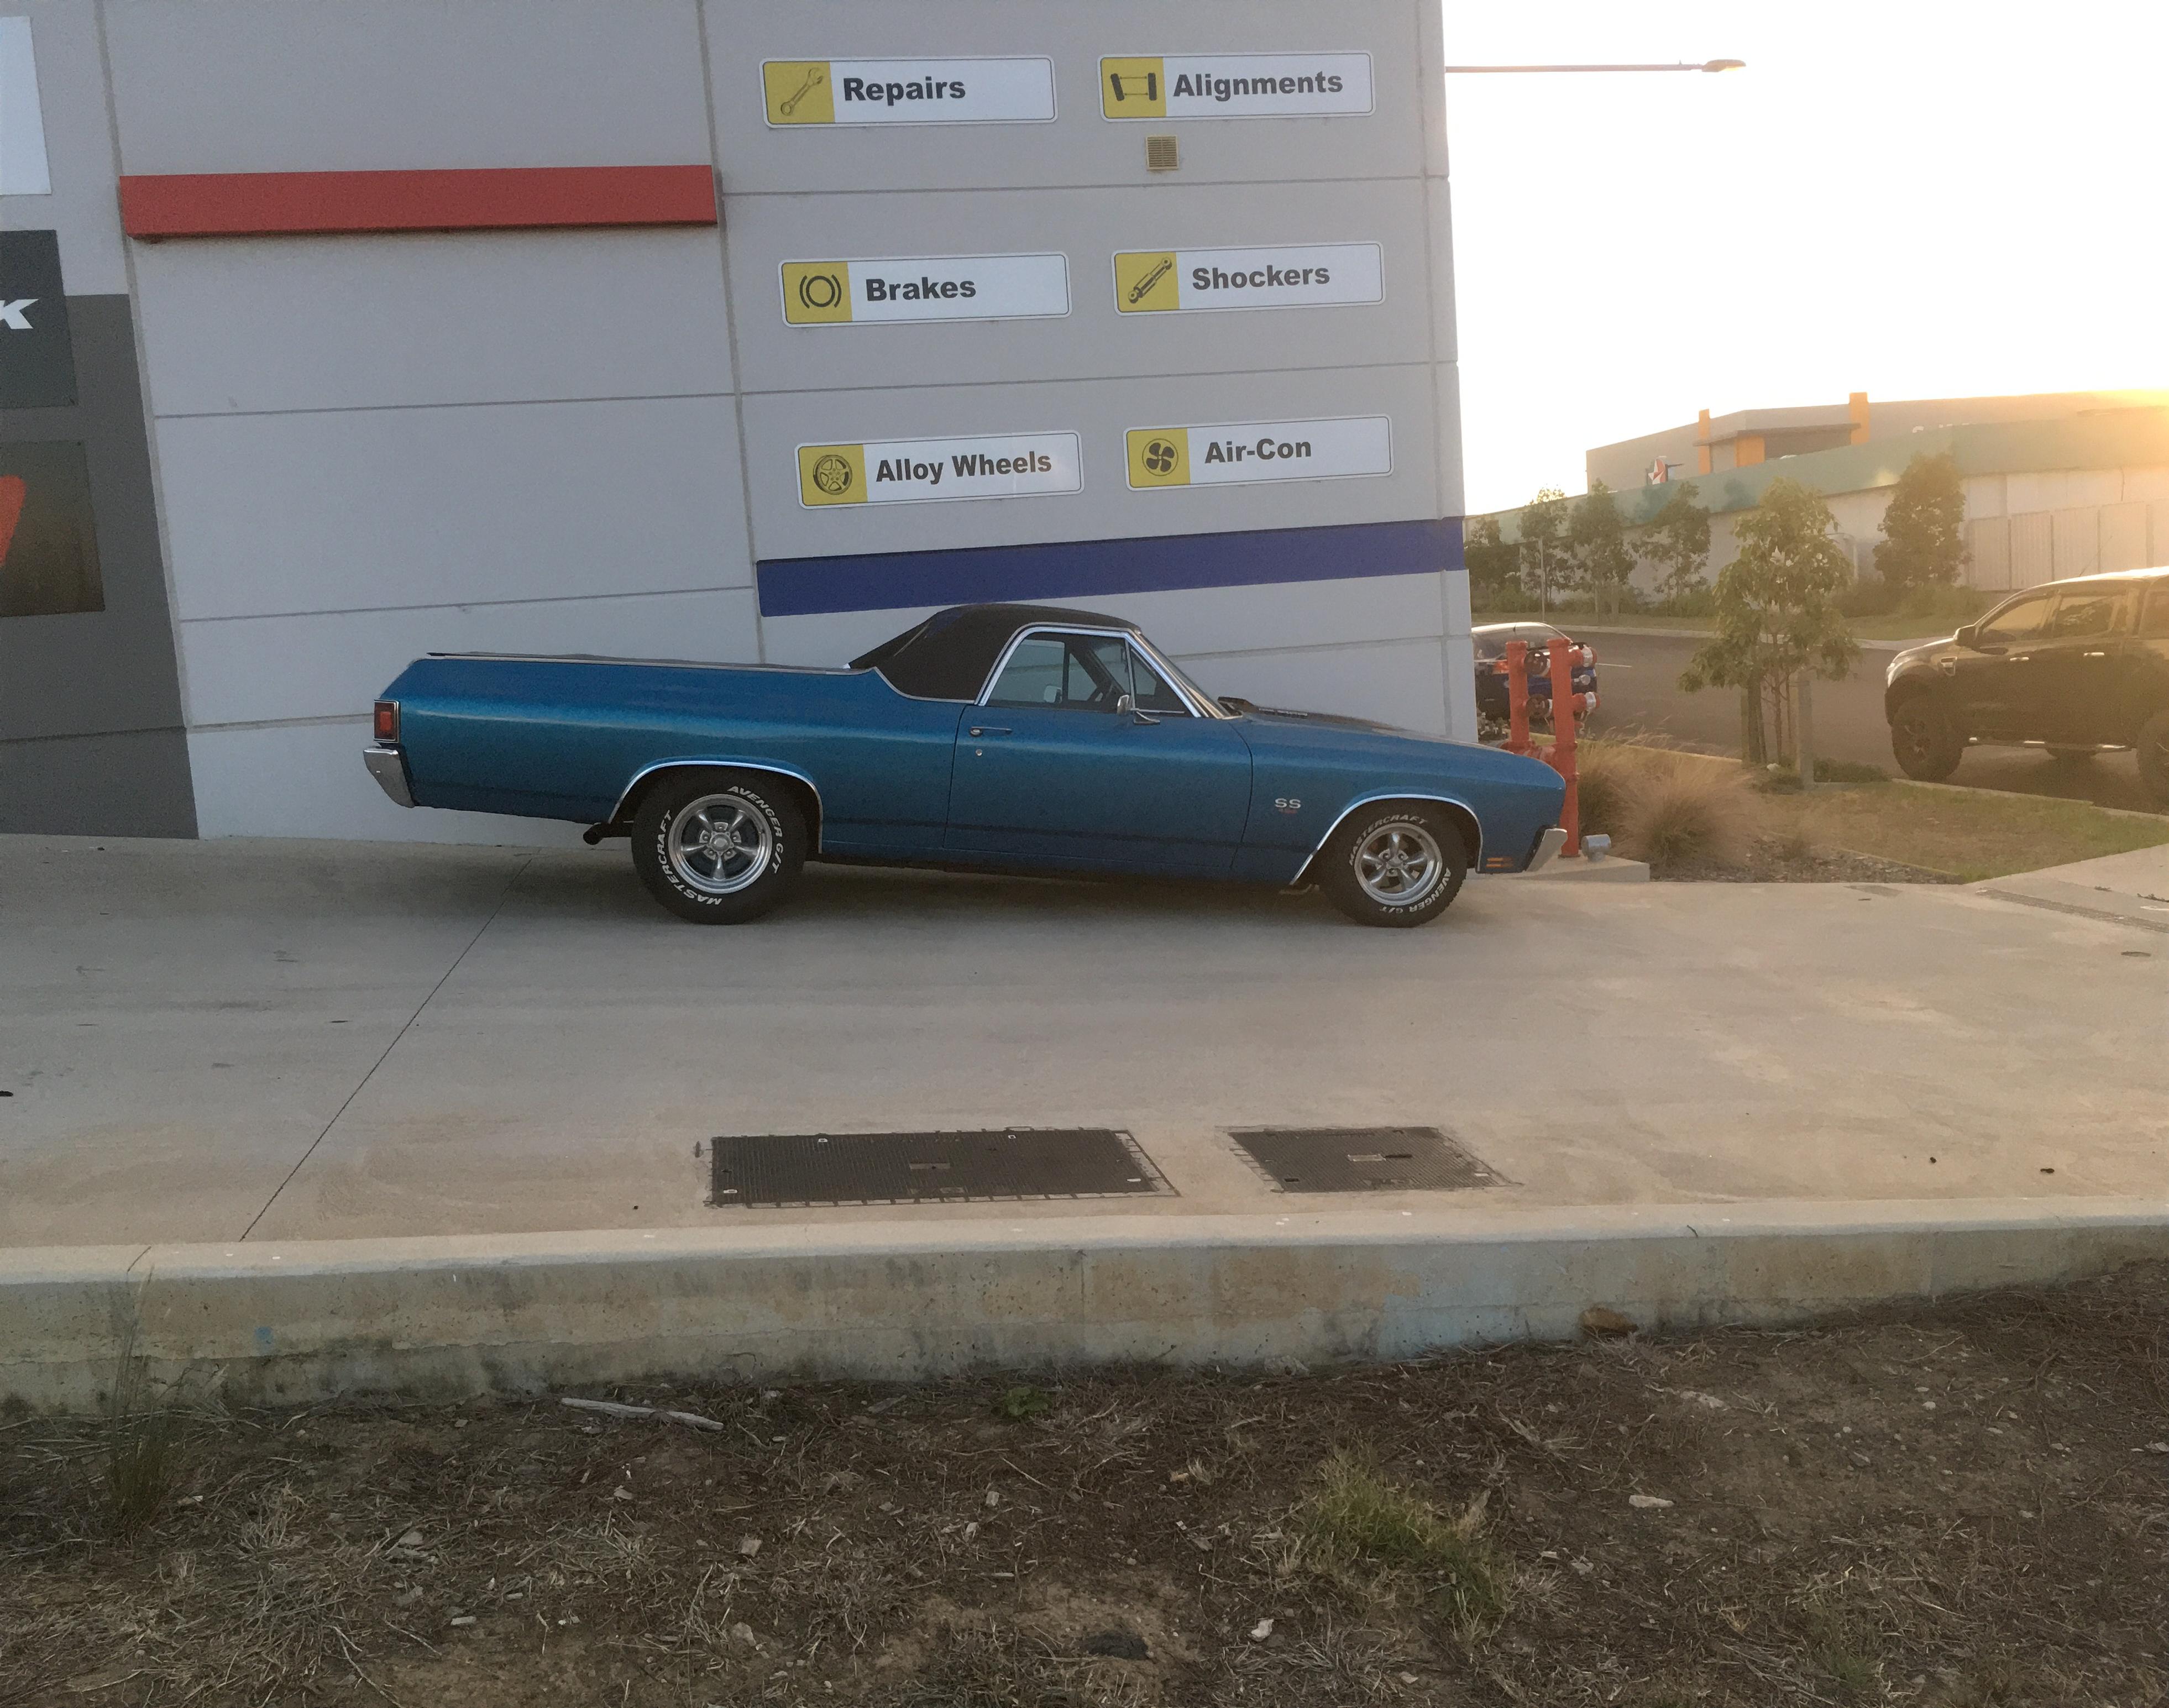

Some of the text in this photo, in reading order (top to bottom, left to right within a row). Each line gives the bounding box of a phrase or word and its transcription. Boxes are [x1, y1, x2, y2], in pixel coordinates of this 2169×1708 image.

[843, 76, 965, 106] Repairs
[1173, 71, 1343, 101] Alignments
[866, 276, 976, 302] Brakes
[1192, 265, 1330, 290] Shockers
[1204, 438, 1312, 464] Air-Con
[876, 450, 1052, 485] Alloy Wheels
[1275, 798, 1301, 809] SS
[727, 785, 784, 874] AVENGER G/T
[657, 809, 722, 905] MASTERCRAFT
[1410, 867, 1452, 913] AVENGER
